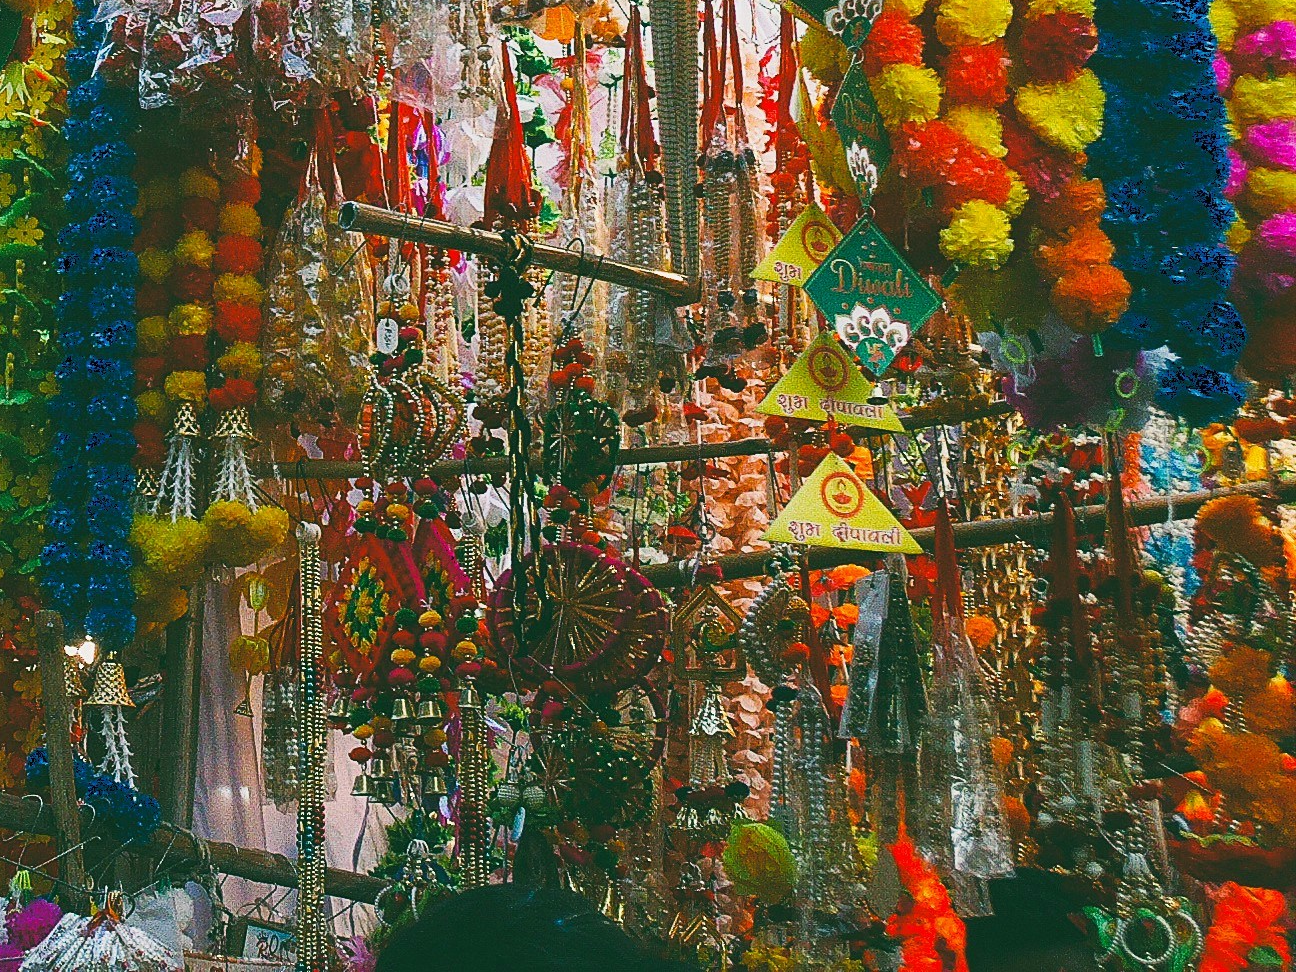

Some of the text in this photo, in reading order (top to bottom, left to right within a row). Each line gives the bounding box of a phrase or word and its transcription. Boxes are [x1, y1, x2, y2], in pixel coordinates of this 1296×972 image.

[774, 261, 803, 282] शुभ
[830, 258, 915, 298] Diwali
[777, 393, 810, 415] शुभ
[788, 520, 903, 546] शुभ दीपावली
